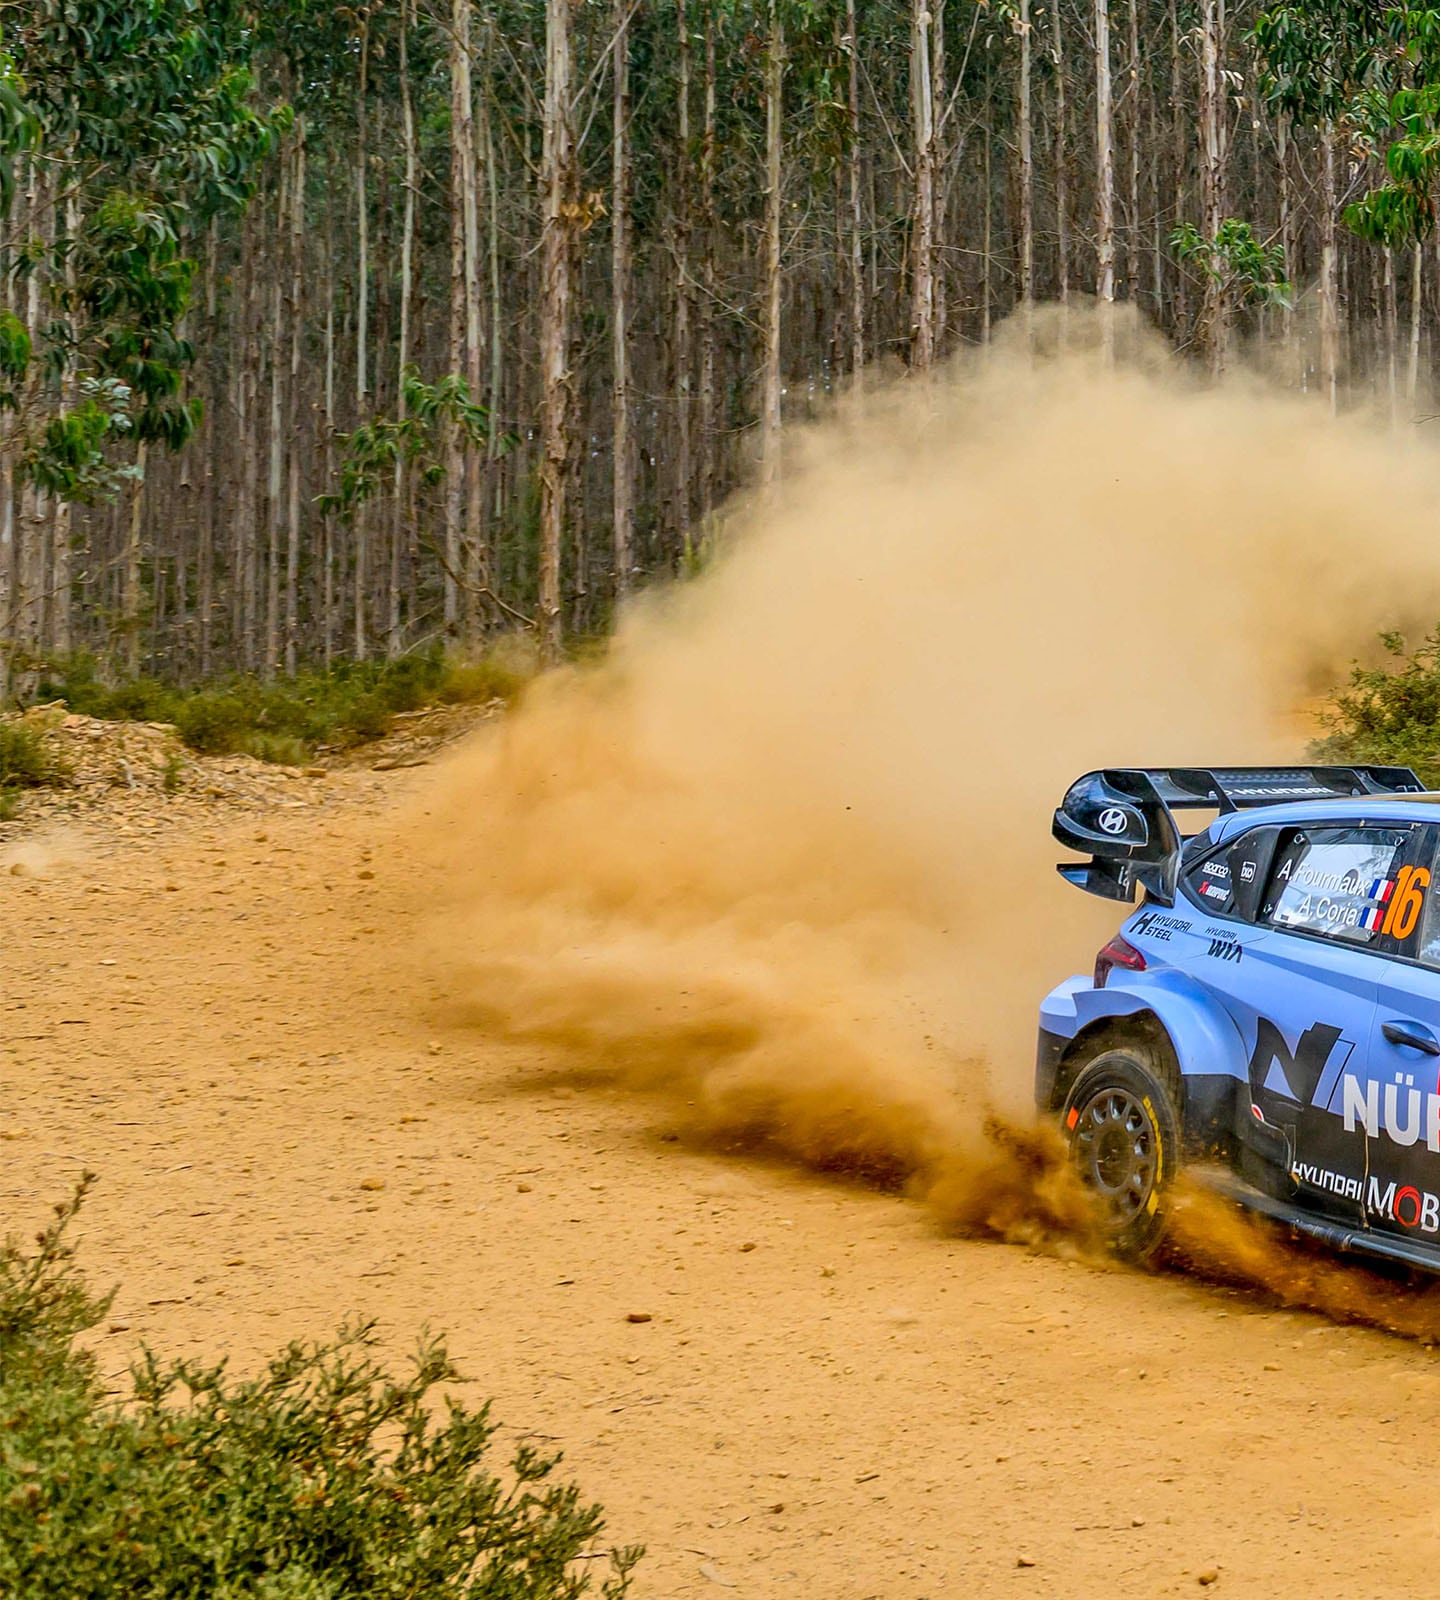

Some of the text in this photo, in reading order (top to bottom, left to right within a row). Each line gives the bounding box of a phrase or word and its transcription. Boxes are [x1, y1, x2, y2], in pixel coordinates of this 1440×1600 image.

[1294, 863, 1371, 897] Fourmaux
[1316, 897, 1360, 927] Coria
[1381, 865, 1431, 940] 16
[1145, 926, 1173, 942] STEEL
[1153, 915, 1193, 933] HYUNDAI
[1205, 926, 1238, 940] HYUNDAI
[1207, 939, 1243, 963] WIA
[1292, 1161, 1363, 1201] HYUNDAI
